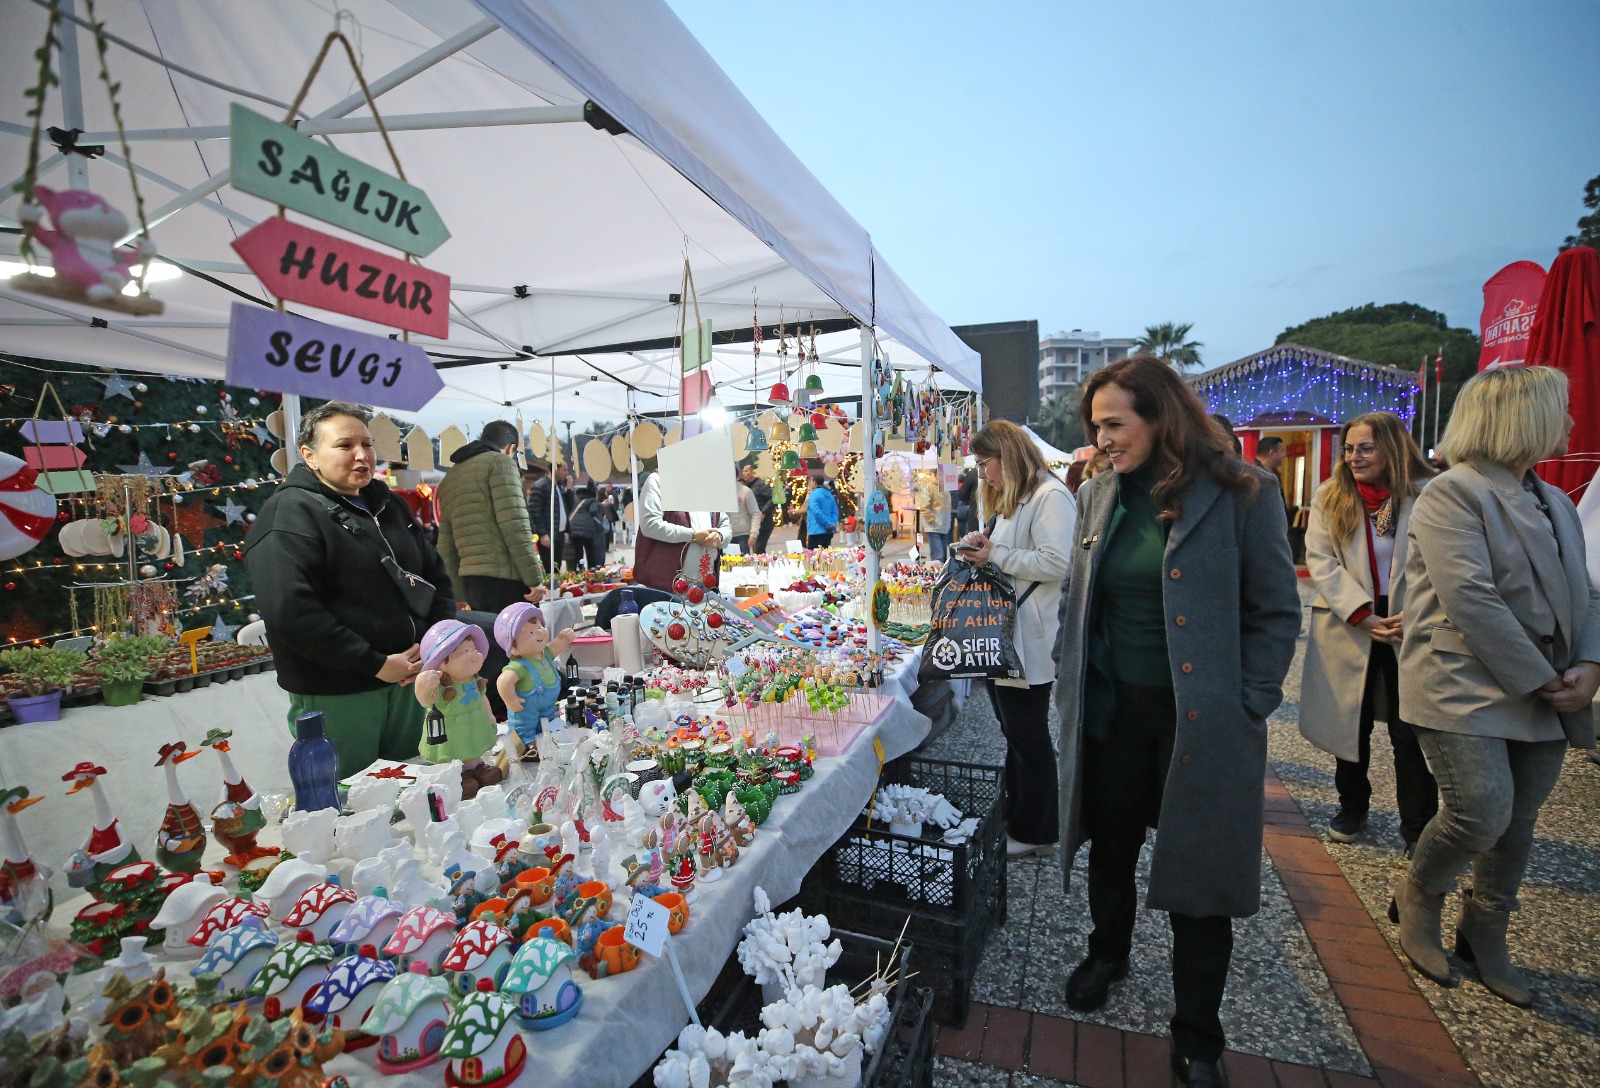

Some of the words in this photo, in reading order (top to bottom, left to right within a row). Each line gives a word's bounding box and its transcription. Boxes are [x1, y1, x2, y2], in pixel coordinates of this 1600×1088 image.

[258, 139, 421, 236] SAĞLIK
[280, 240, 433, 315] HUZUR
[265, 331, 402, 388] SEVGİ
[965, 652, 1001, 667] ATIK
[634, 919, 648, 941] 25
